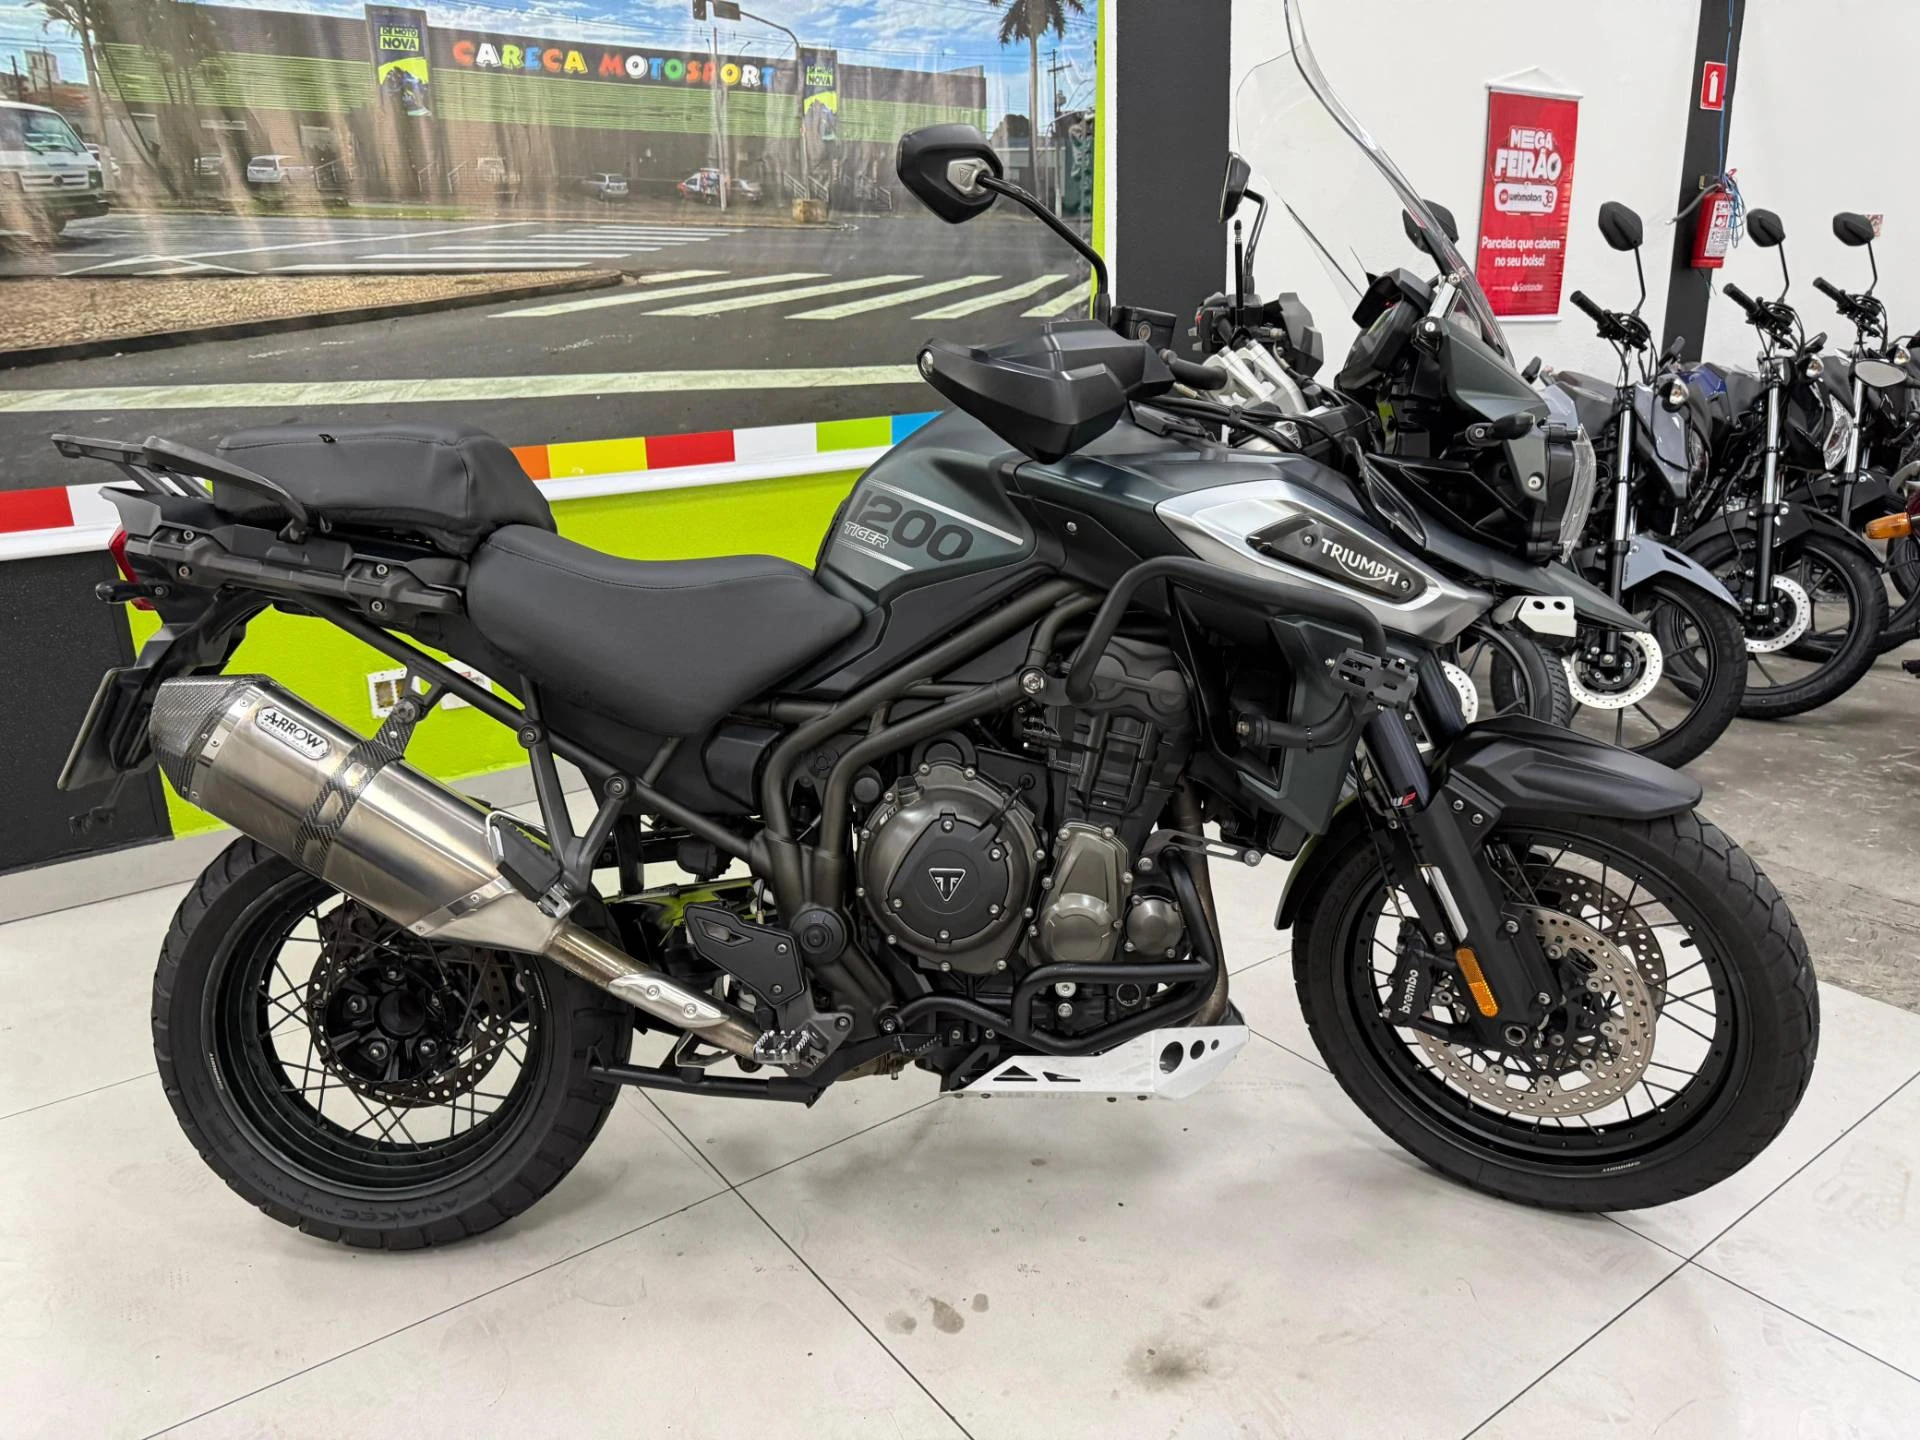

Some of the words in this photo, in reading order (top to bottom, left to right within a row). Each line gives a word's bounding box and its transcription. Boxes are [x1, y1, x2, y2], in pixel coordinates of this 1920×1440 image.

[382, 37, 417, 49] NOVA
[452, 40, 588, 74] CARECA
[598, 52, 777, 89] MOTOSPORT
[1509, 128, 1554, 151] MEGA
[1494, 147, 1562, 181] FEIRÃO
[1508, 192, 1542, 202] webmotors
[1481, 235, 1516, 249] Parcelas
[1517, 240, 1534, 253] que
[1534, 237, 1560, 249] cabem
[1494, 256, 1506, 267] no
[1506, 256, 1521, 267] seu
[1522, 253, 1546, 267] bolso!
[844, 520, 890, 549] TIGER
[847, 489, 975, 562] 1200
[1321, 538, 1399, 585] TRIUMPH
[264, 711, 324, 748] ARROW
[1398, 969, 1419, 1014] brembo
[340, 1197, 459, 1221] ANAKEE
